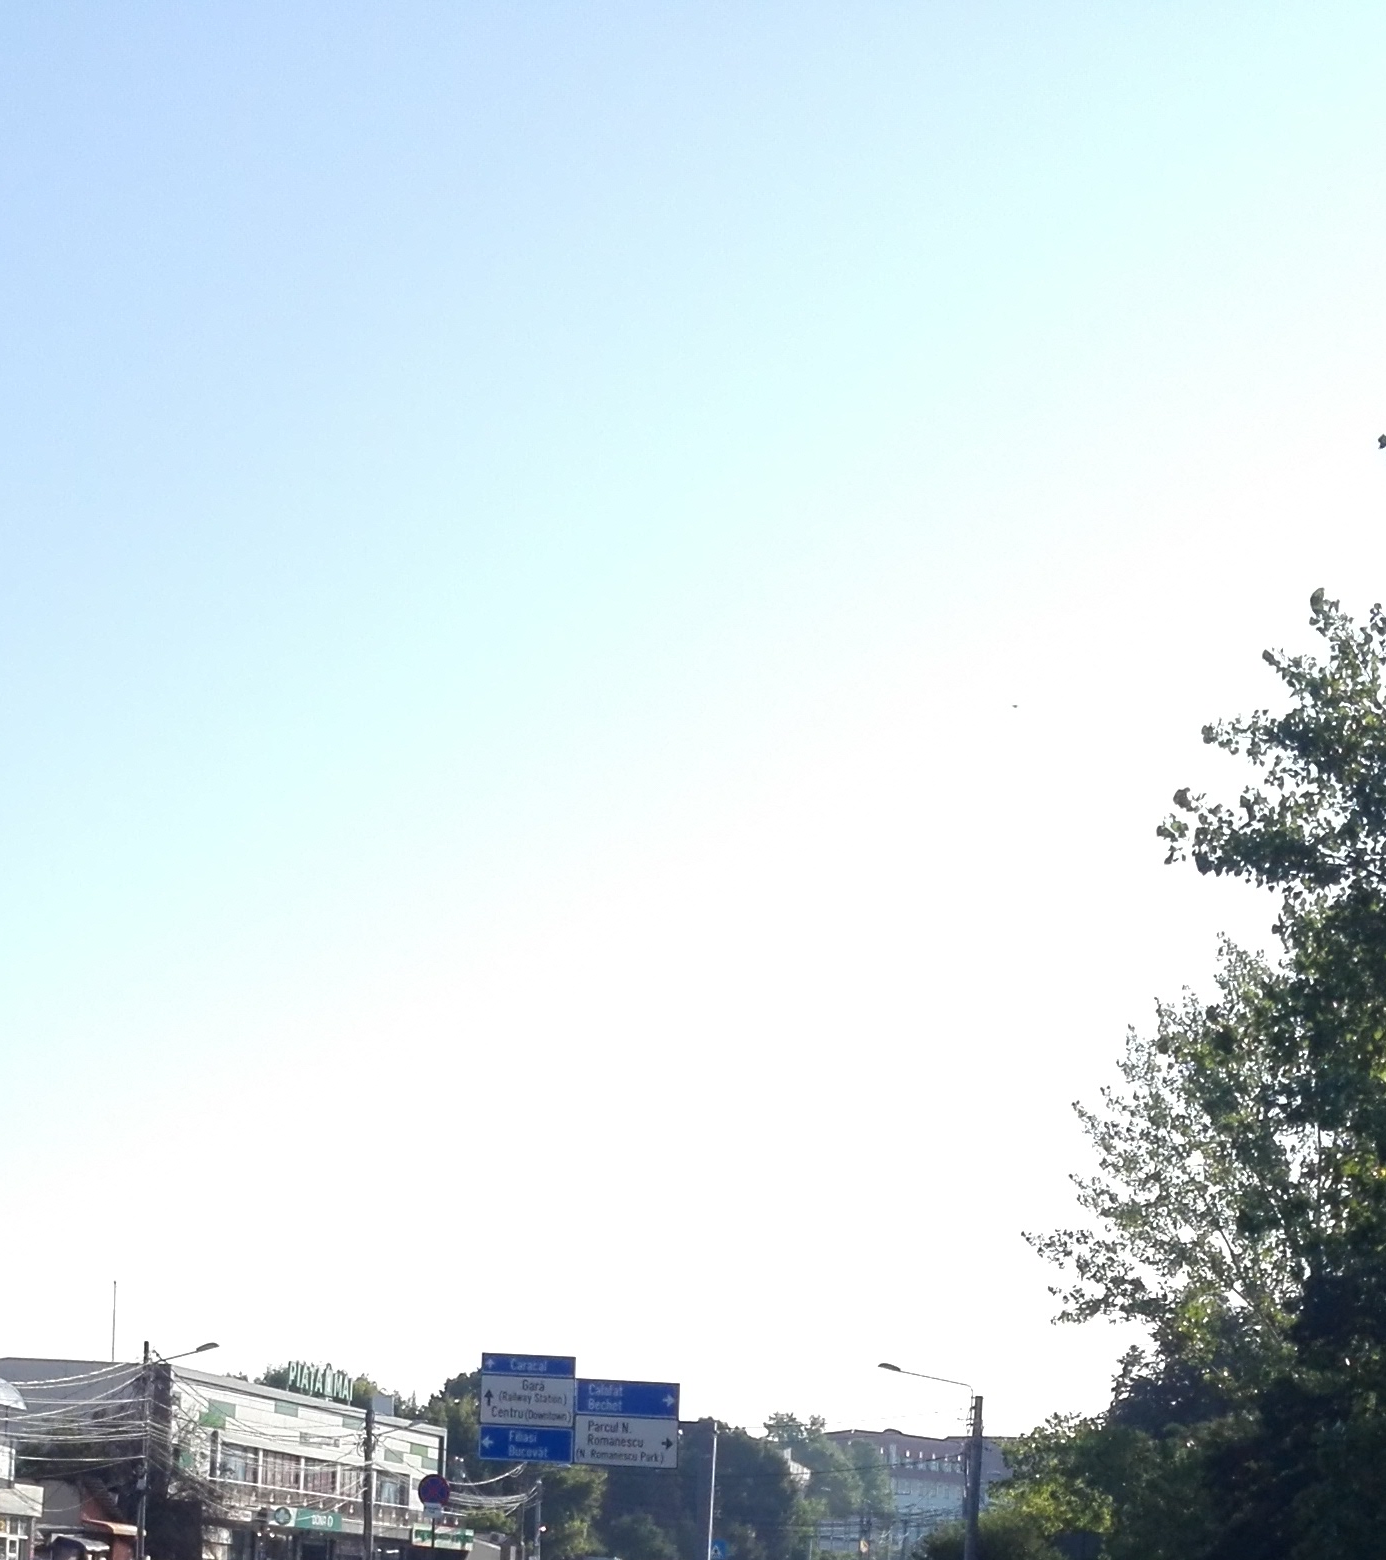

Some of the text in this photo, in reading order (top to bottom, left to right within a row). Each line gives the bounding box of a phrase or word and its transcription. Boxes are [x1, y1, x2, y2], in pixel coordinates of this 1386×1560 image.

[511, 1359, 547, 1371] Caracal
[334, 1372, 353, 1401] MAI
[589, 1384, 623, 1397] Calafat
[588, 1398, 623, 1411] Bechet
[491, 1406, 524, 1419] Centru
[588, 1420, 619, 1433] Parcul
[587, 1434, 644, 1448] Romanescu
